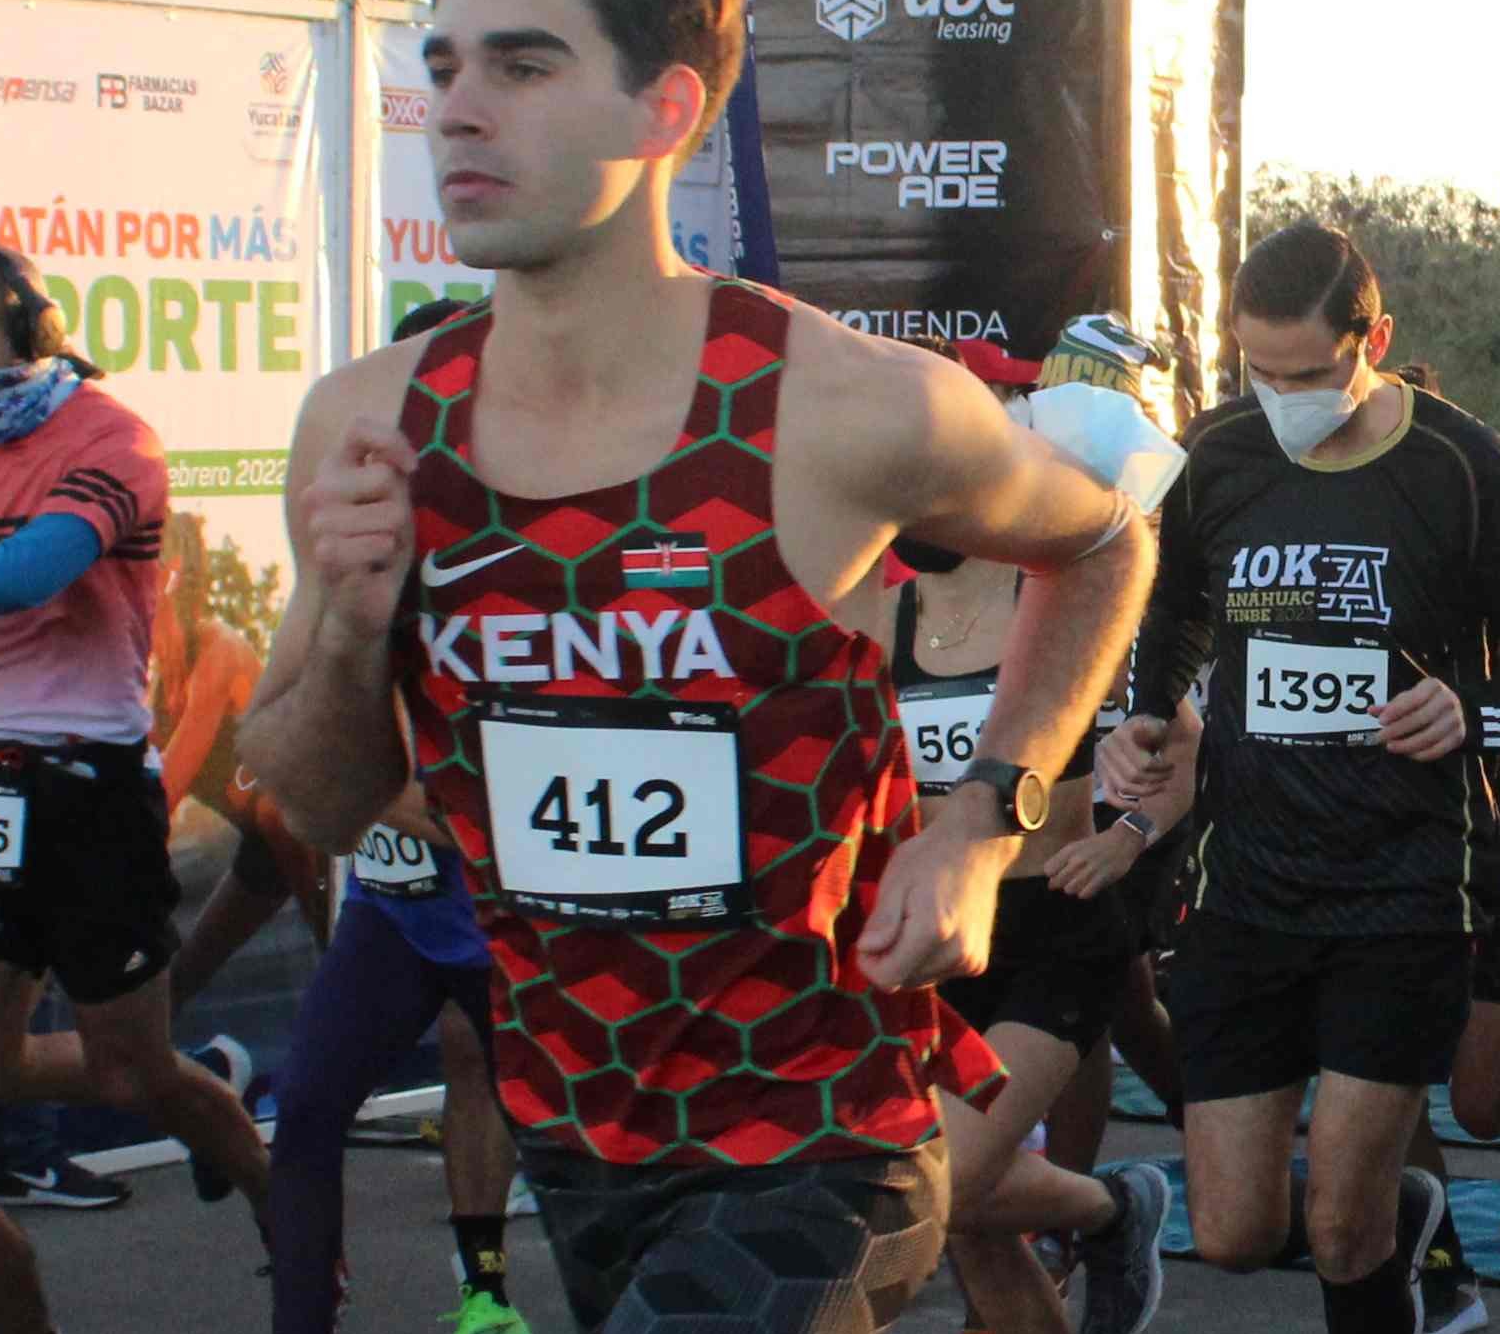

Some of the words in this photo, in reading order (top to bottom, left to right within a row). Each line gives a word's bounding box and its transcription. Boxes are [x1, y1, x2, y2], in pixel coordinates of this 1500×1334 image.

[937, 12, 1013, 44] leasing
[128, 73, 198, 98] FARMACIAS
[142, 95, 184, 114] BAZAR
[825, 140, 1008, 175] POWER
[898, 176, 1001, 209] ADE
[116, 211, 200, 261] POR
[209, 205, 298, 262] MÁS
[235, 457, 287, 486] 2022
[1227, 543, 1322, 589] 10K
[1225, 587, 1316, 608] ANÁHUAC
[1225, 608, 1271, 623] FINBE
[419, 608, 737, 684] KENYA
[1256, 667, 1377, 716] 1393
[916, 720, 982, 764] 56
[530, 774, 689, 859] 412
